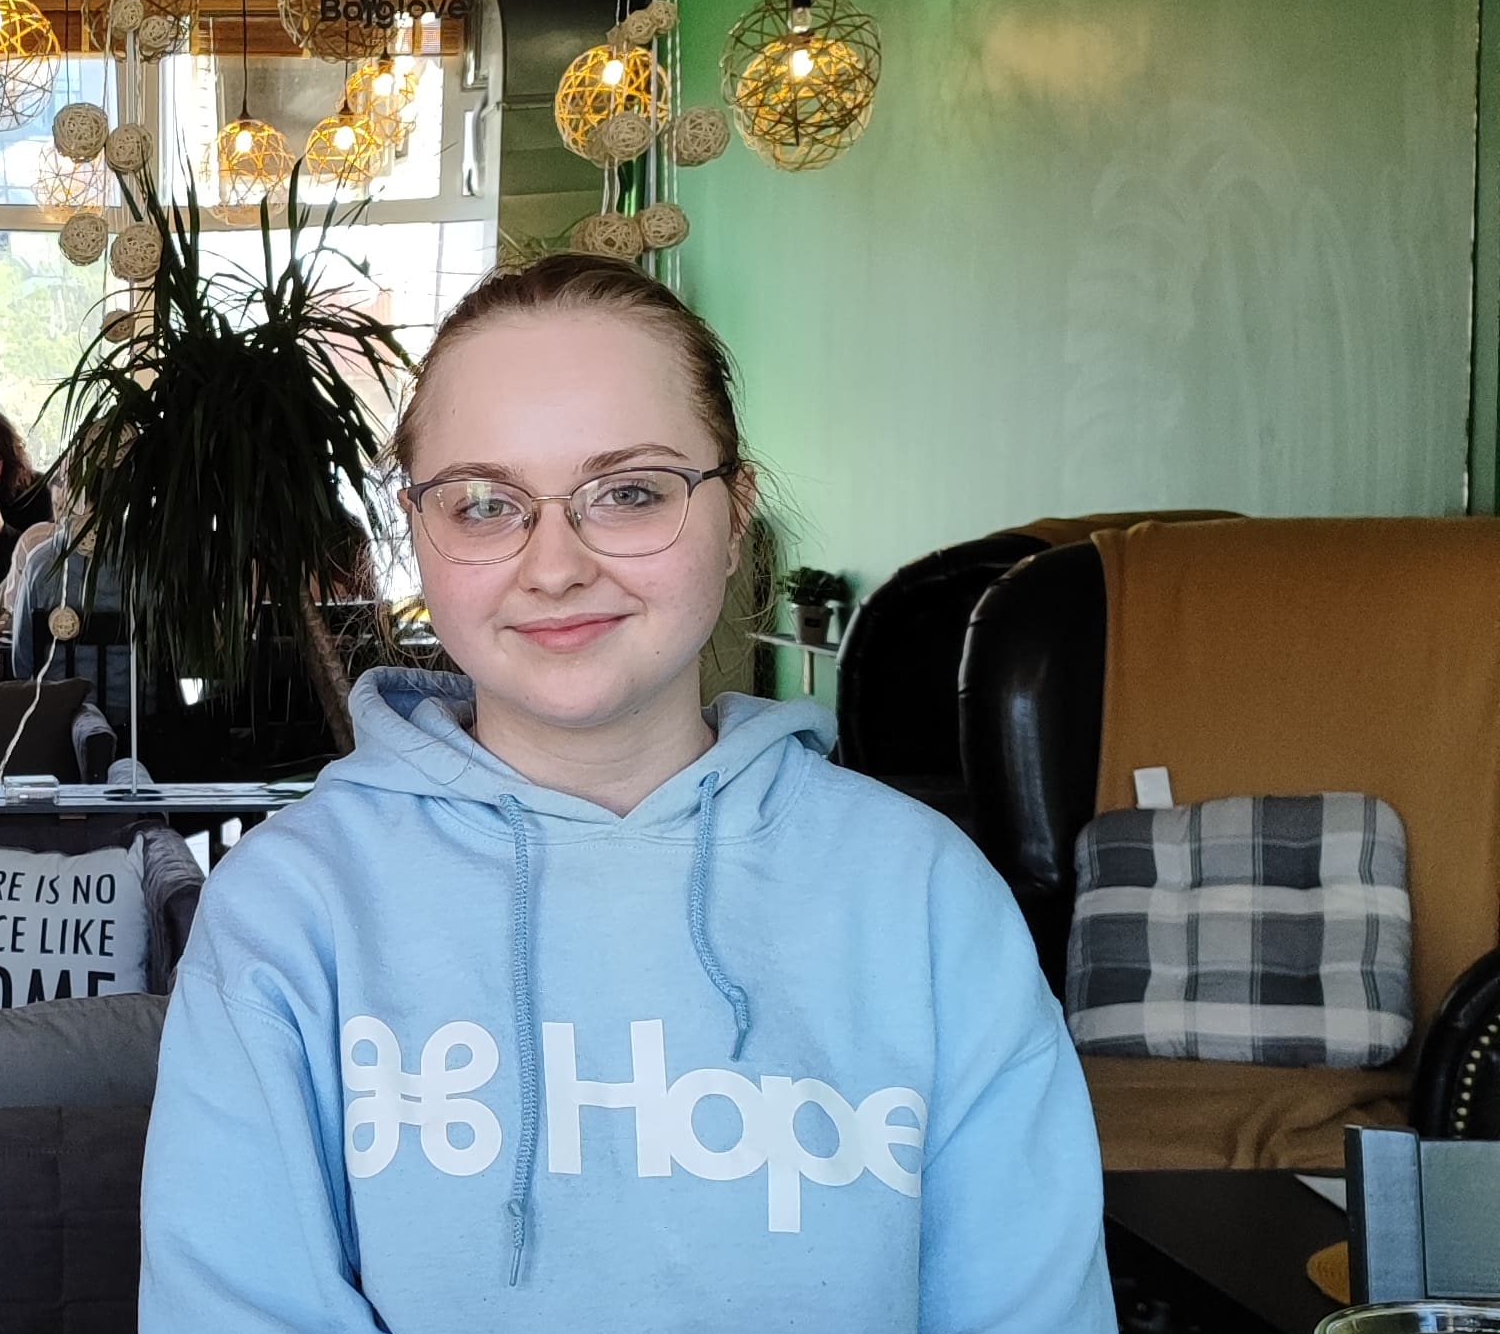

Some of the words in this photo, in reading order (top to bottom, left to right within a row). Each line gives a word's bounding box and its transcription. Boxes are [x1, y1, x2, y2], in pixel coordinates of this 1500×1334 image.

[34, 873, 60, 905] IS
[72, 873, 116, 905] NO
[39, 918, 116, 958] LIKE
[542, 1019, 927, 1234] Hope
